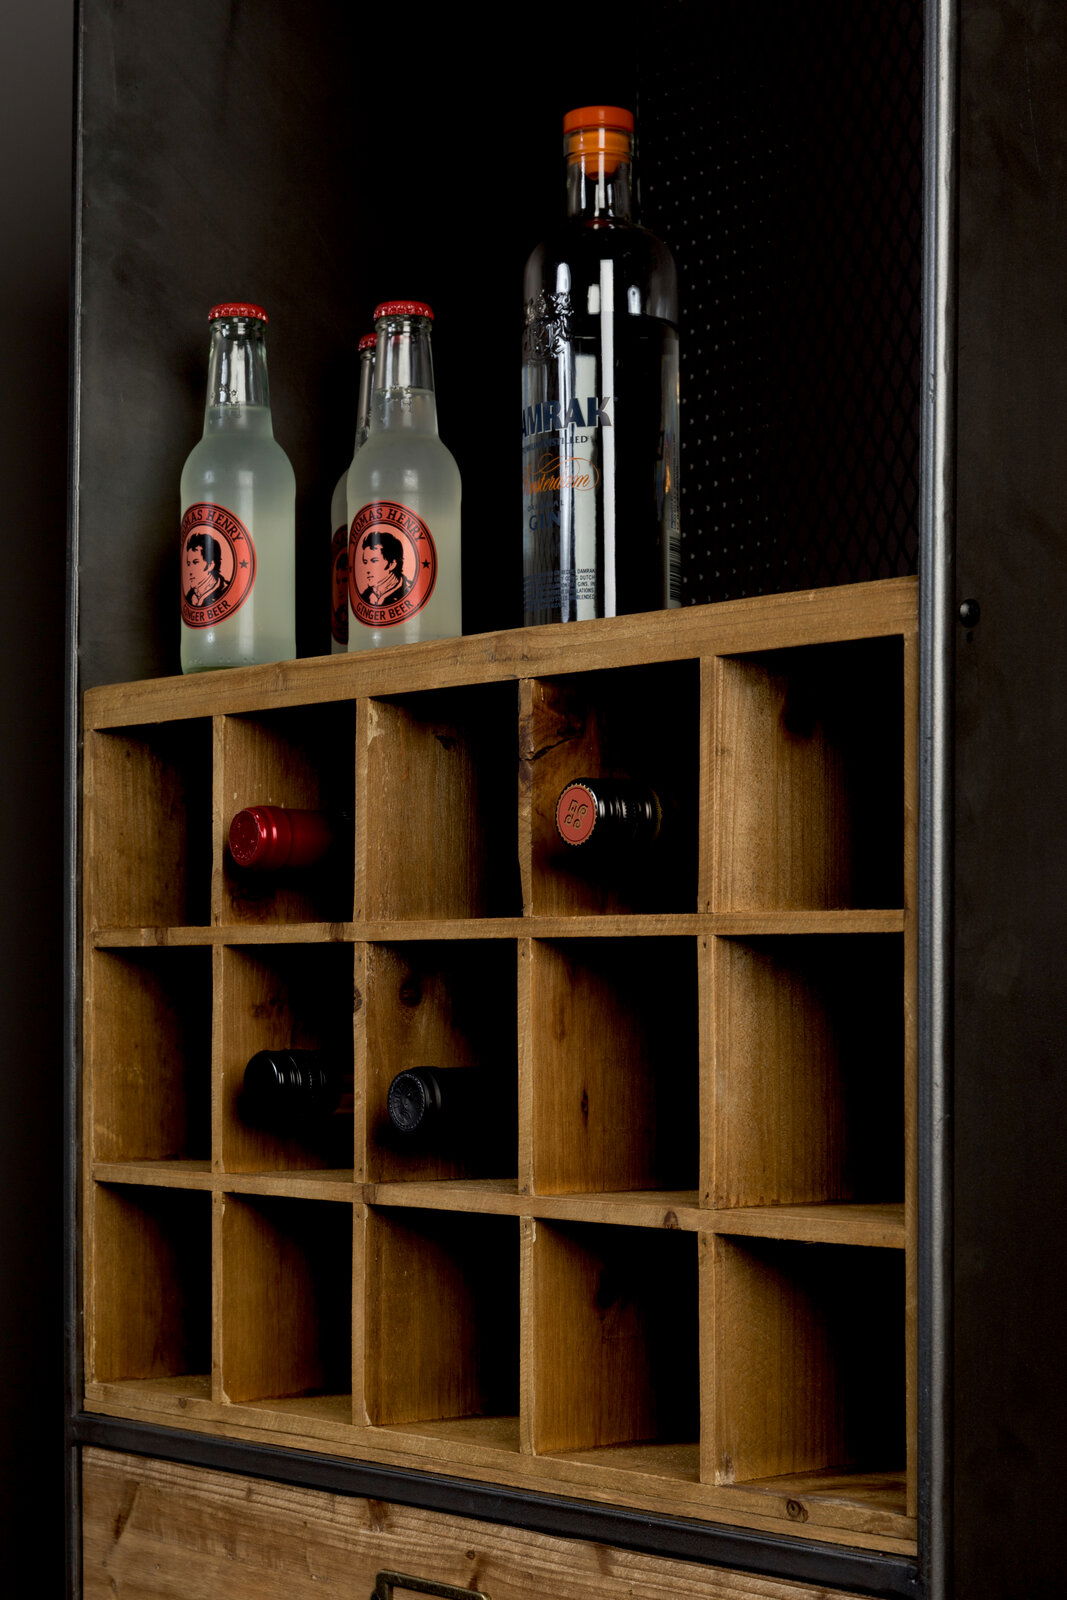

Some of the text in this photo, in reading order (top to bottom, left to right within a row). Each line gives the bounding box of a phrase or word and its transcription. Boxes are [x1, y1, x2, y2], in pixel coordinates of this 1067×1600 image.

[522, 396, 614, 438] AMRAK
[206, 510, 244, 544] HENRY
[386, 508, 427, 542] HENRY
[207, 599, 231, 620] BEER
[356, 599, 413, 621] GINGER BEER
